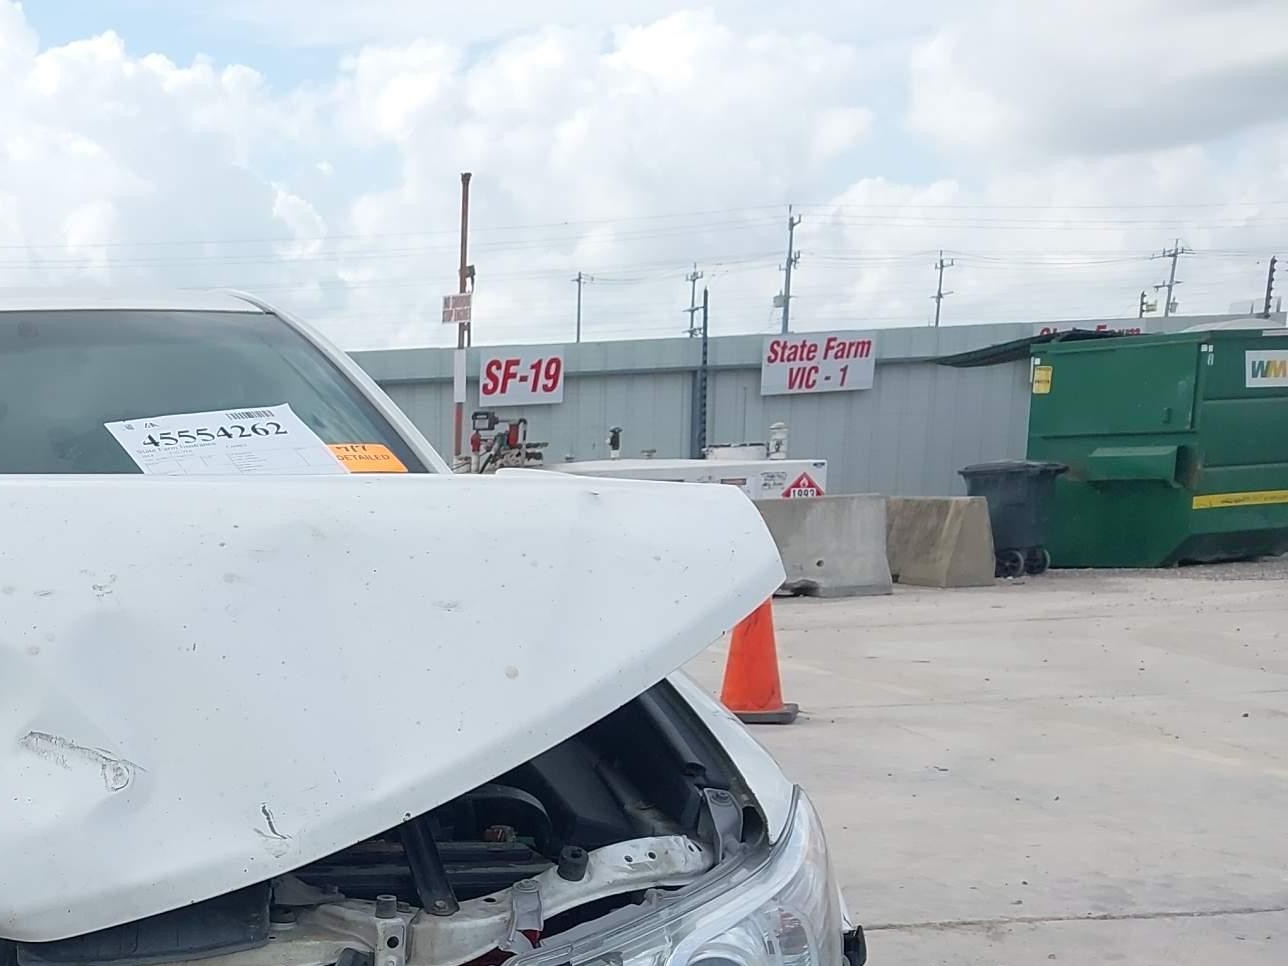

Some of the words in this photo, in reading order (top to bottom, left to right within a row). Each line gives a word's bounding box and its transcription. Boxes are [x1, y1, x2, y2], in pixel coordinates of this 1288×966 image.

[766, 339, 819, 365] State
[822, 335, 873, 362] Farm
[481, 356, 563, 396] SF-19
[786, 365, 820, 391] VIC
[838, 364, 850, 388] 1
[1251, 359, 1288, 379] WM
[143, 421, 289, 447] 45554262
[336, 453, 391, 462] DETAILED
